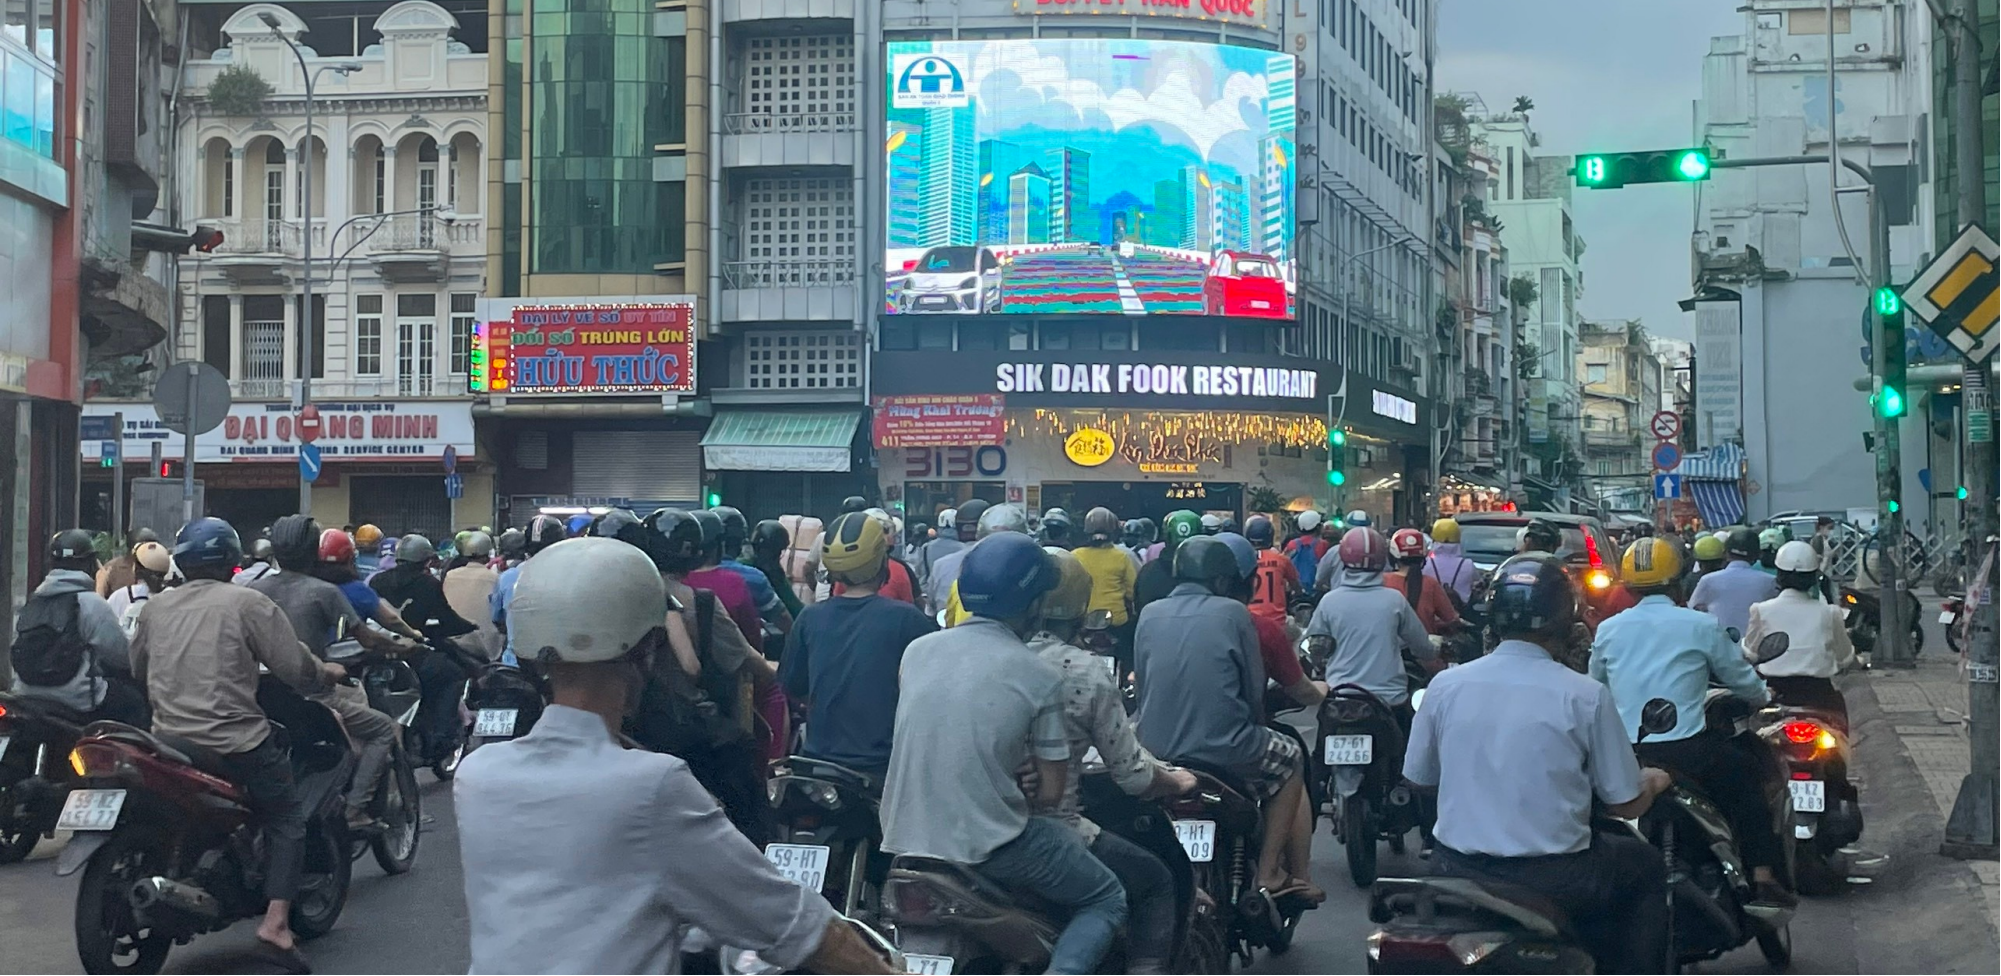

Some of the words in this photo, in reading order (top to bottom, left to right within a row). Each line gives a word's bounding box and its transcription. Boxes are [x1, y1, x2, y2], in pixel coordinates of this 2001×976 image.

[521, 312, 547, 326] ĐẠI
[551, 311, 570, 323] LÝ
[574, 310, 595, 324] VÉ
[599, 309, 620, 323] SỐ
[624, 312, 644, 323] UY
[650, 310, 676, 322] TÍN
[549, 327, 576, 345] SỐ
[580, 328, 641, 344] TRÚNG
[647, 328, 684, 343] LỚN
[515, 348, 585, 386] HỮU
[592, 346, 679, 386] THỨC
[996, 362, 1044, 392] SIK
[1051, 363, 1111, 394] DAK
[1118, 364, 1188, 395] FOOK
[1193, 366, 1317, 399] RESTAURANT
[923, 405, 951, 416] Khai
[224, 415, 268, 442] ĐẠI
[372, 415, 438, 439] MINH
[344, 446, 383, 454] SERVICE
[387, 446, 424, 454] CENTER
[774, 848, 818, 869] 59-H1
